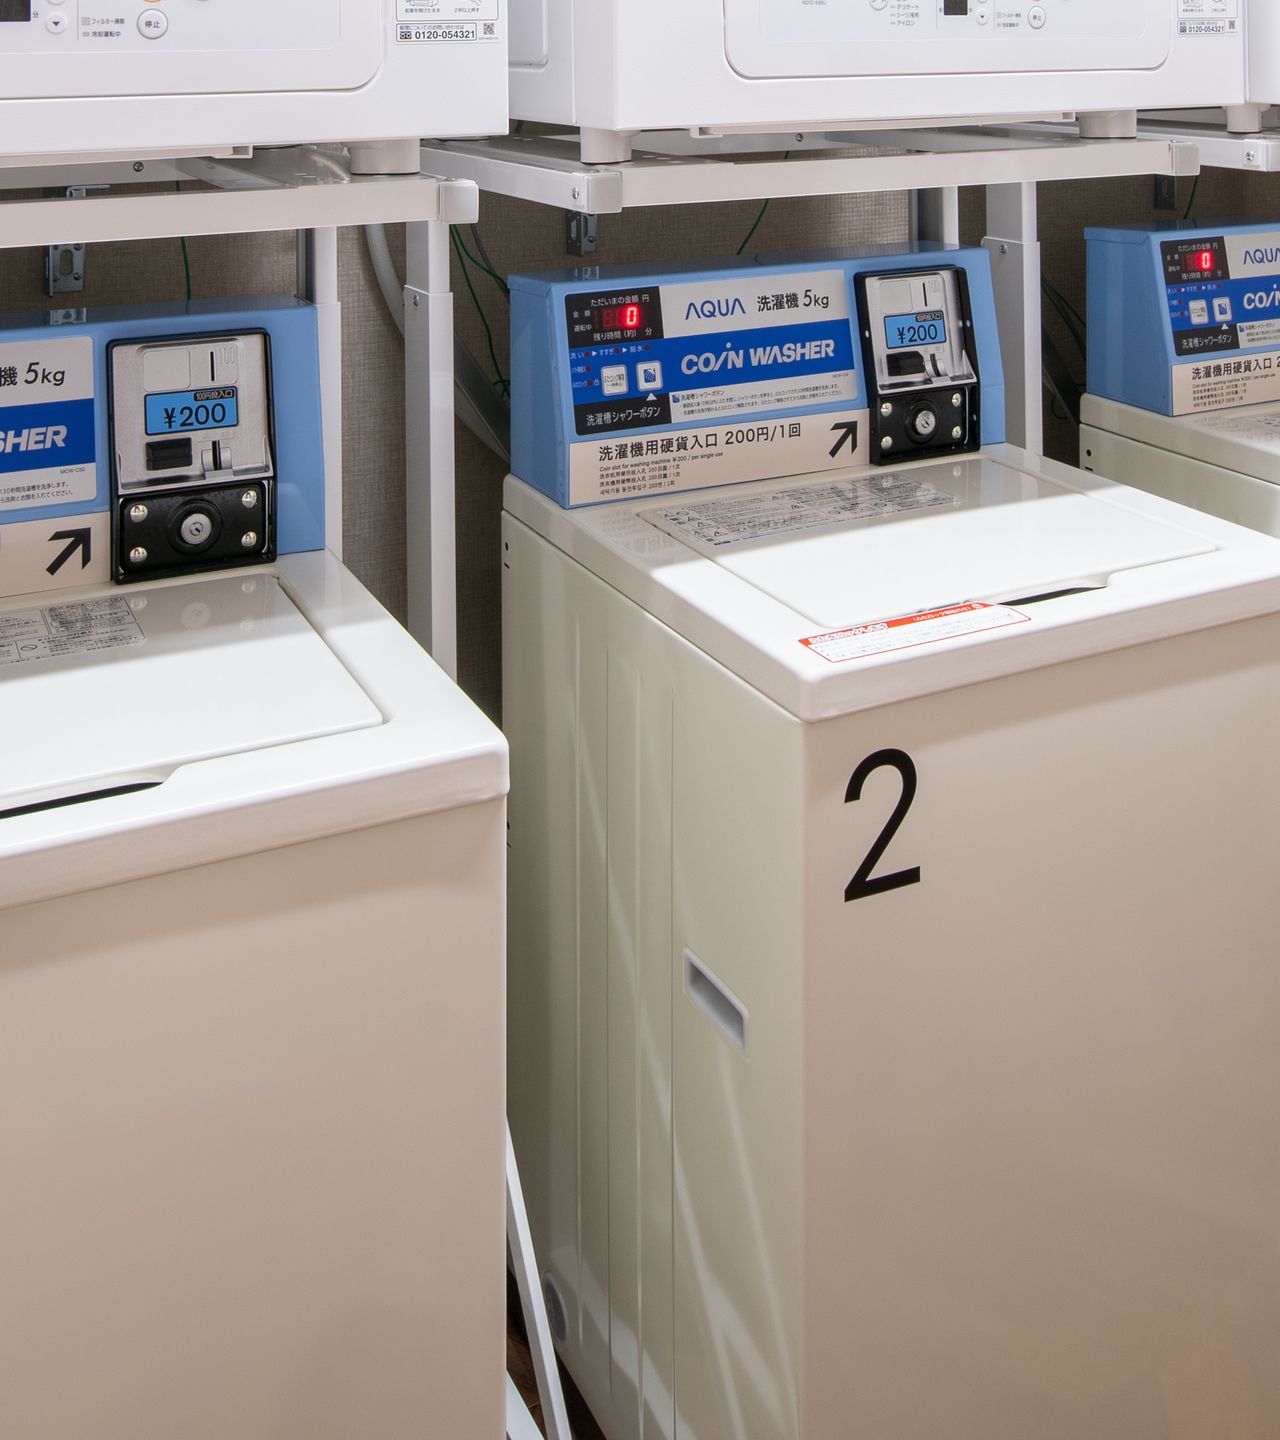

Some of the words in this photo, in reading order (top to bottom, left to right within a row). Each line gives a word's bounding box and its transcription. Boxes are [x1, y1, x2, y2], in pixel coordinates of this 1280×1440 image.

[415, 30, 474, 39] 0120-054321
[1202, 253, 1209, 268] 0
[591, 295, 639, 306] ただいまの金額
[642, 294, 649, 302] 円
[685, 298, 746, 320] AQUA
[757, 292, 799, 312] 洗濯機
[804, 289, 829, 308] 5kg
[627, 307, 636, 325] 0
[645, 327, 652, 336] 分
[897, 324, 937, 344] ¥200
[681, 342, 743, 375] COIN
[750, 339, 835, 366] WASHER
[24, 362, 65, 386] 5kg
[1192, 358, 1272, 380] 洗濯機用硬貨入口
[164, 403, 226, 428] ¥200
[586, 407, 660, 426] 洗濯槽シャワーボタン
[599, 433, 718, 462] 洗濯機用硬貨入口
[725, 423, 801, 445] 200円/1回
[844, 748, 920, 902] 2
